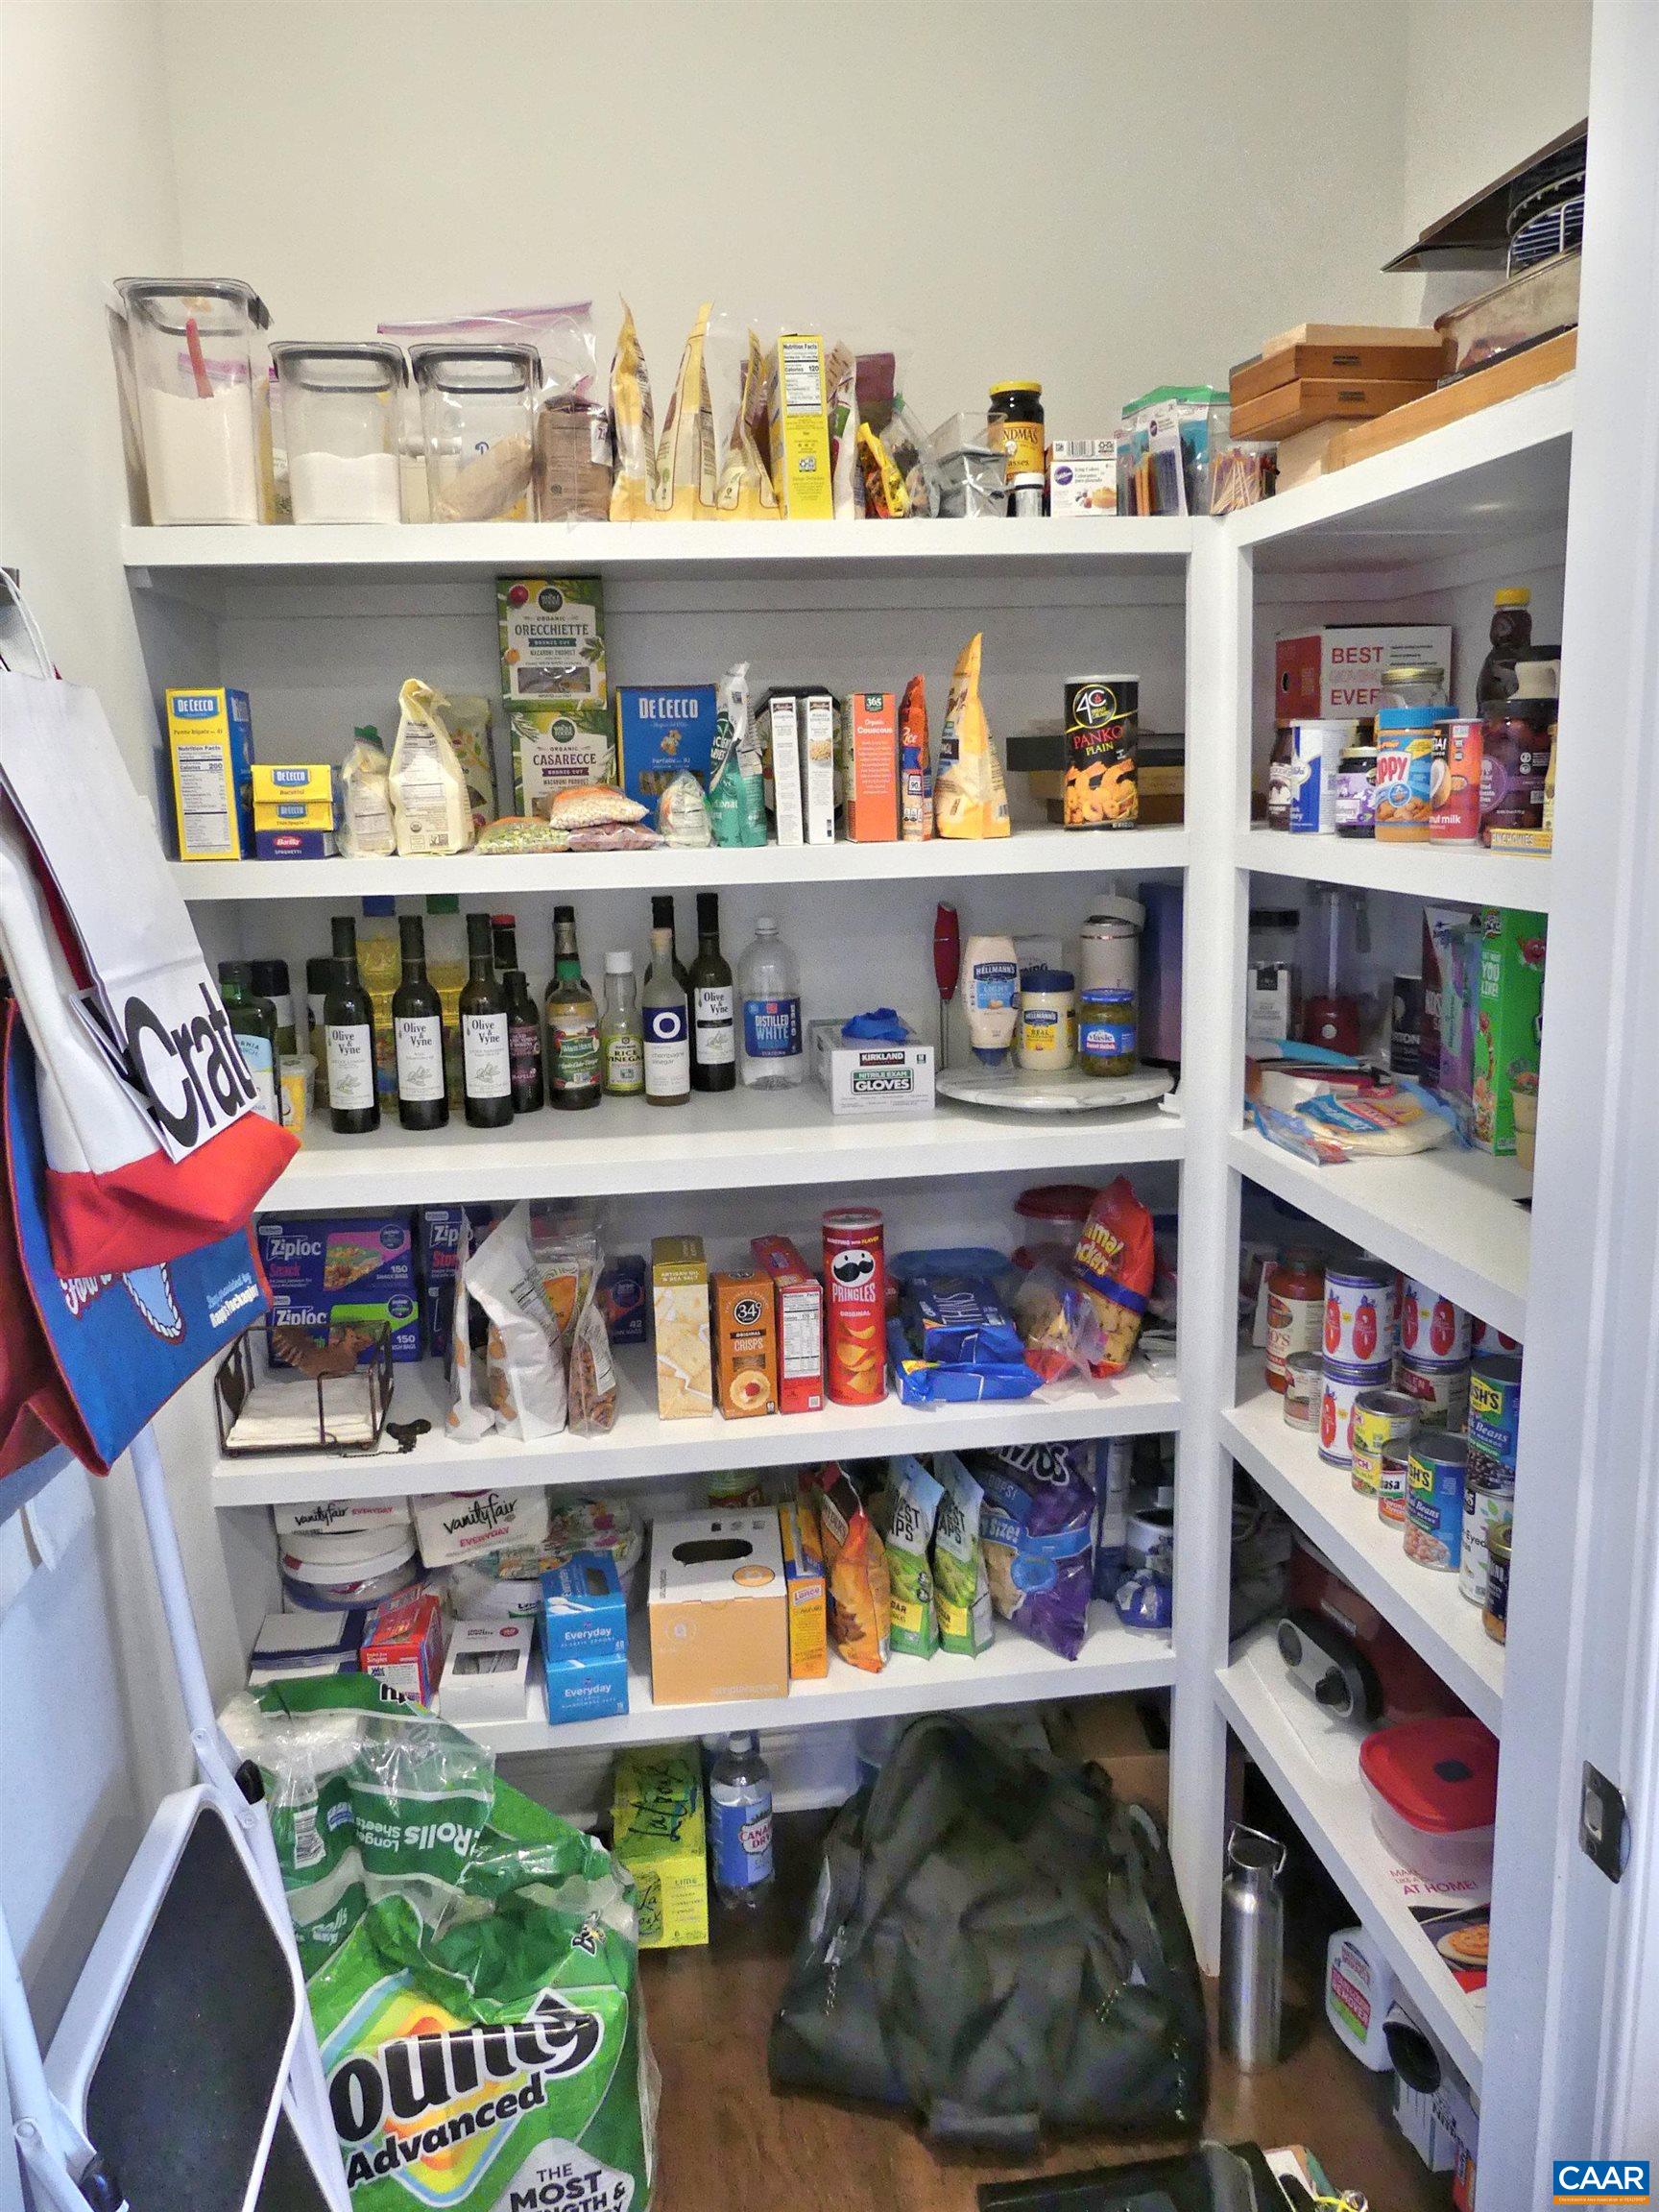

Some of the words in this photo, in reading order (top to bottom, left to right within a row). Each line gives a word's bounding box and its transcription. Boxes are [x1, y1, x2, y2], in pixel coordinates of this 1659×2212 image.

[515, 624, 589, 636] ORECCHIETTE
[1331, 646, 1384, 664] BEST
[866, 697, 883, 707] 365
[1072, 725, 1123, 749] PANKO
[1086, 741, 1114, 756] PLAIN
[533, 753, 597, 766] CASARECCE
[1441, 814, 1461, 824] milk
[704, 991, 725, 1002] Olive
[709, 1004, 730, 1016] Vyne
[403, 1022, 427, 1033] Olive
[471, 1019, 495, 1030] Olive
[755, 1014, 789, 1027] DISTILLED
[331, 1030, 355, 1042] Olive
[479, 1033, 501, 1045] Vyne
[755, 1026, 789, 1041] WHITE
[410, 1036, 433, 1048] Vyne
[338, 1043, 361, 1056] Vyne
[861, 1052, 904, 1061] KIRKLAND
[855, 1078, 910, 1092] GLOVES
[271, 1239, 323, 1262] Ziploc
[831, 1283, 876, 1303] PRINGLES
[276, 1310, 327, 1326] Ziploc
[396, 1334, 416, 1344] 150
[733, 1337, 764, 1352] CRISPS
[1476, 1421, 1509, 1442] Beans
[350, 1506, 395, 1515] EVERYDAY
[1415, 1500, 1440, 1521] Beans
[459, 1526, 511, 1548] EVERYDAY
[565, 1626, 613, 1642] Everyday
[565, 1684, 613, 1698] Everyday
[403, 1822, 473, 1858] Rolls
[1404, 1884, 1421, 1895] AT
[1424, 1881, 1478, 1894] HOME!
[347, 2071, 545, 2189] Advanced
[537, 2163, 573, 2183] THE
[510, 2170, 603, 2212] MOST
